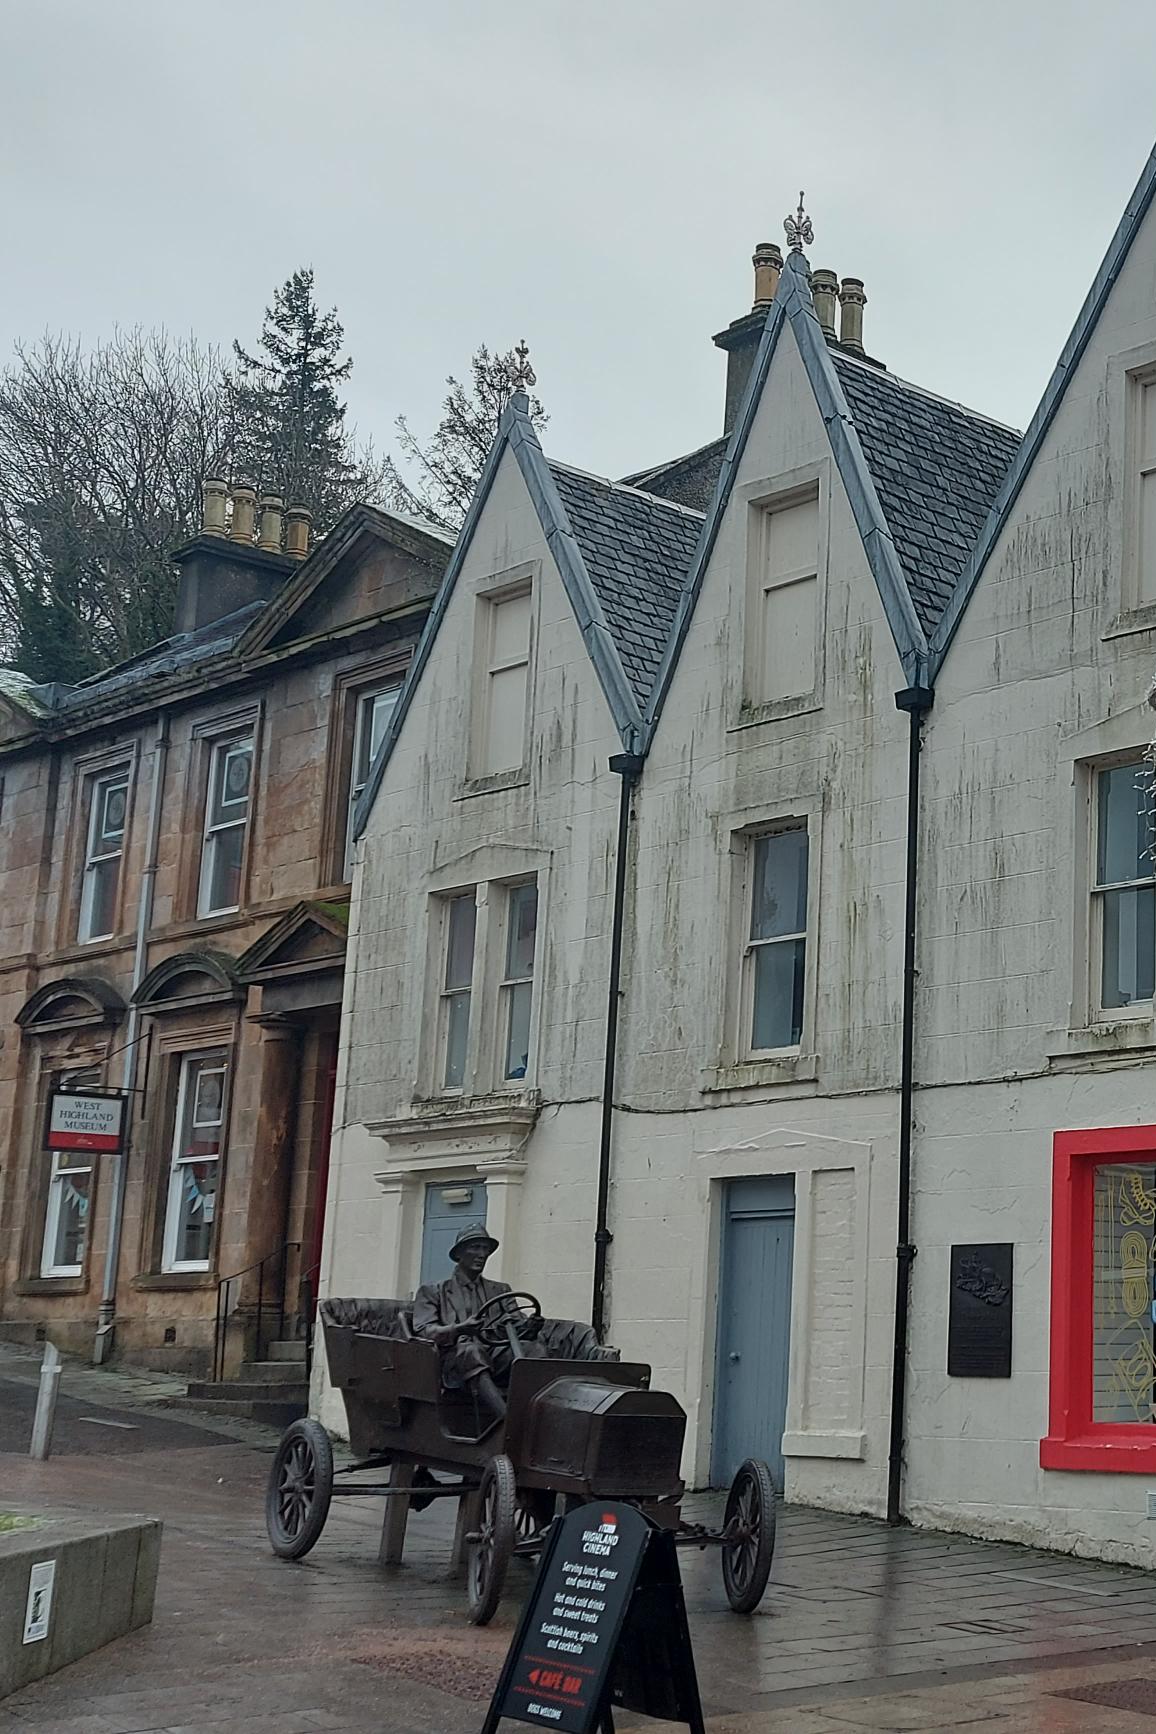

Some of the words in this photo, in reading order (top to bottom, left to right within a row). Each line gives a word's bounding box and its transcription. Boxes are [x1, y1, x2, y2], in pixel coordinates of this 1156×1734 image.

[74, 1101, 102, 1110] WEST
[60, 1110, 114, 1122] HIGHLAND
[64, 1121, 107, 1131] MUSEUM
[582, 1530, 619, 1546] HIGHLAND
[583, 1542, 611, 1556] CINEMA
[562, 1561, 582, 1575] Serving
[582, 1565, 599, 1578] lunch,
[600, 1568, 618, 1580] dinner
[565, 1576, 577, 1587] and
[577, 1578, 592, 1589] quick
[554, 1593, 565, 1603] Hot
[565, 1596, 576, 1605] and
[576, 1597, 588, 1607] cold
[587, 1599, 606, 1611] drinks
[553, 1607, 564, 1617] and
[563, 1609, 580, 1620] sweet
[580, 1611, 599, 1623] treats
[541, 1622, 563, 1636] Scottish
[547, 1639, 558, 1649] and
